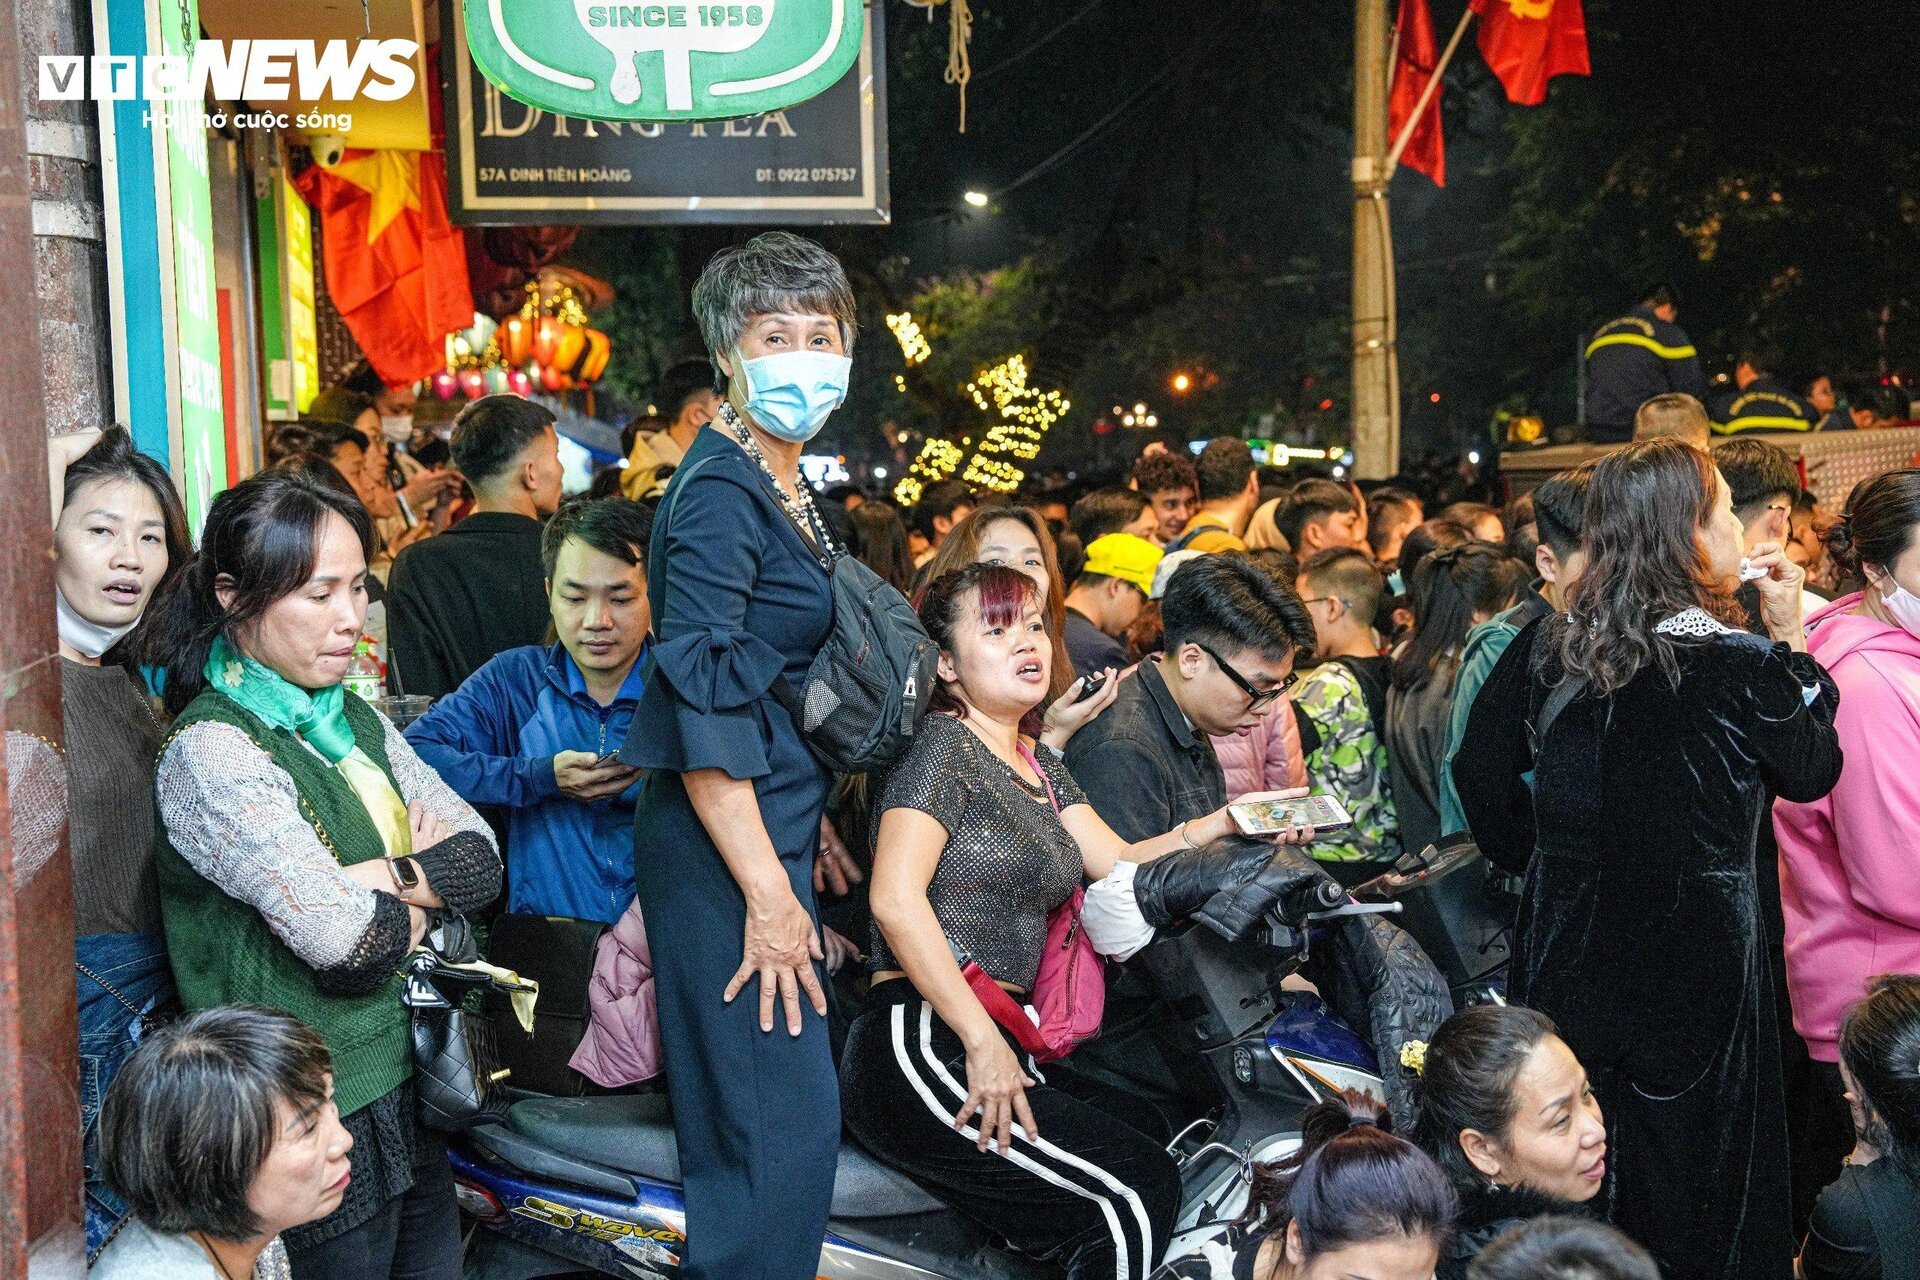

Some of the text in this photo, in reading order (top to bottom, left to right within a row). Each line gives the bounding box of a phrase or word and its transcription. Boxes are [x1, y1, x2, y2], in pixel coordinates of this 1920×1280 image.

[588, 6, 763, 27] SINCE 1958
[480, 167, 507, 182] 57A
